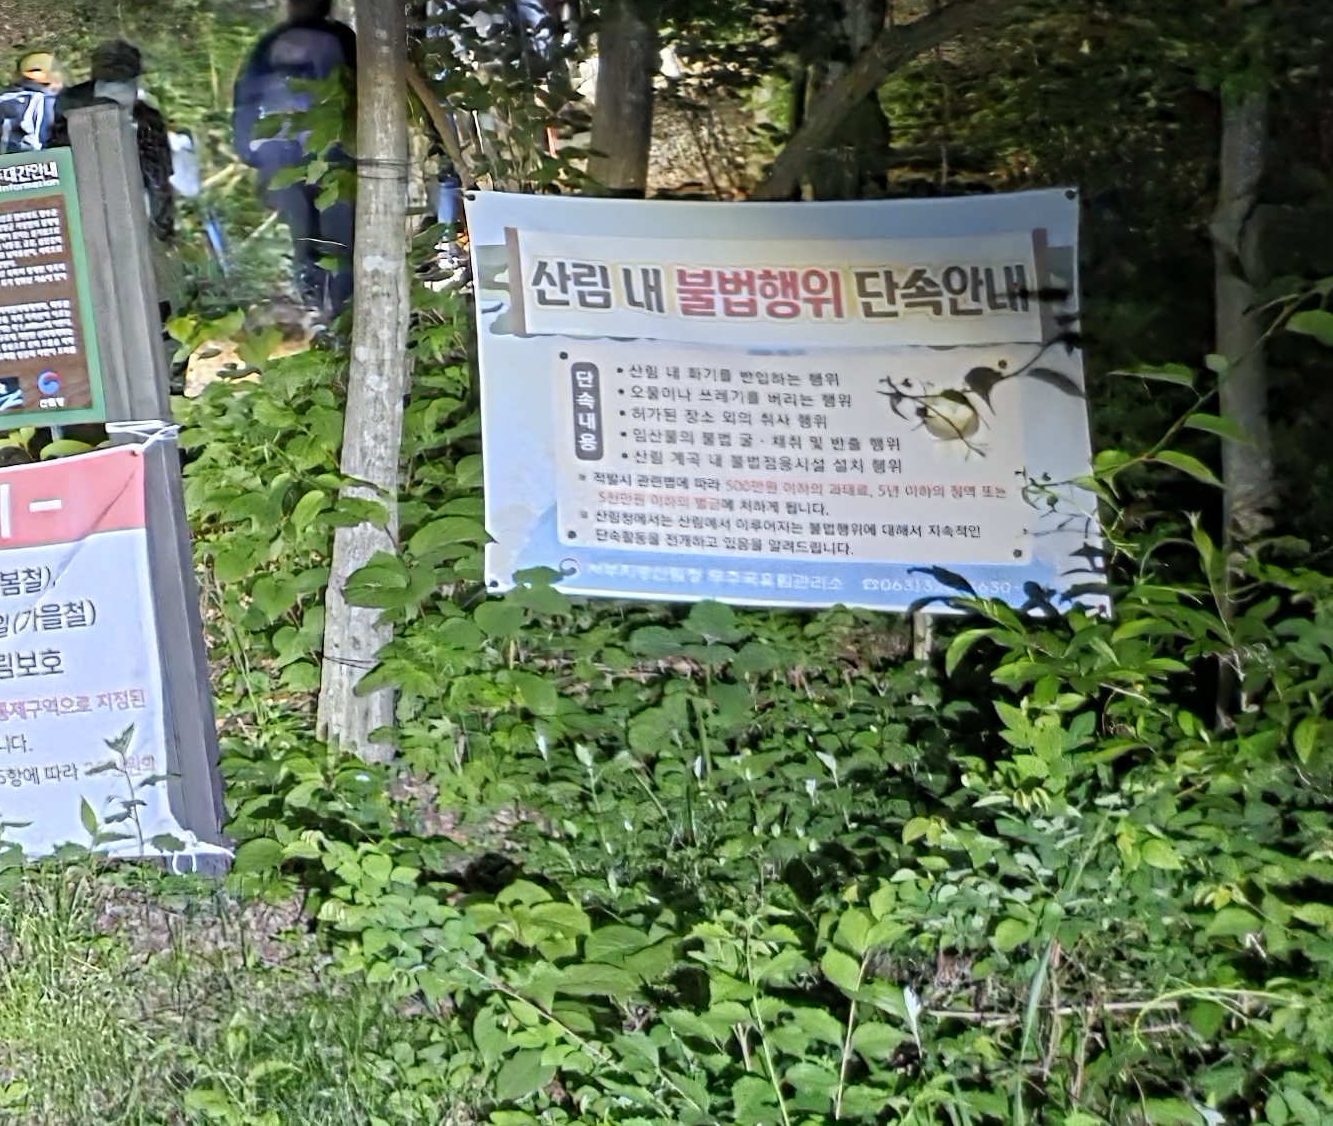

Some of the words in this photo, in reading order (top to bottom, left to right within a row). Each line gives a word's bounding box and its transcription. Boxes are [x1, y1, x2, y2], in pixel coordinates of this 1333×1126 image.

[532, 261, 612, 308] 산림
[622, 268, 665, 313] 내
[677, 269, 844, 319] 불법행위
[853, 264, 1029, 318] 단속안내
[629, 364, 658, 379] 산림
[666, 367, 680, 380] 내
[740, 371, 801, 386] 반입하는
[809, 373, 839, 387] 행위
[631, 385, 691, 402] 오물이나
[699, 389, 759, 405] 쓰레기를
[768, 393, 814, 408] 버리는
[821, 394, 851, 408] 행위
[576, 371, 597, 451] 단속내용
[632, 407, 677, 423] 허가된
[684, 409, 715, 424] 장소
[722, 411, 752, 426] 외의
[760, 412, 790, 427] 취사
[799, 414, 827, 429] 행위
[772, 435, 802, 449] 채취
[810, 436, 823, 451] 및
[869, 437, 900, 452] 행위
[634, 450, 663, 465] 산림
[671, 452, 700, 467] 계곡
[709, 454, 722, 468] 내
[833, 458, 864, 473] 설치
[872, 459, 902, 474] 행위
[905, 485, 945, 498] 이하의
[882, 524, 922, 537] 대해서
[928, 525, 981, 539] 지속적인
[96, 688, 147, 711] 지정된
[44, 762, 78, 781] 따라
